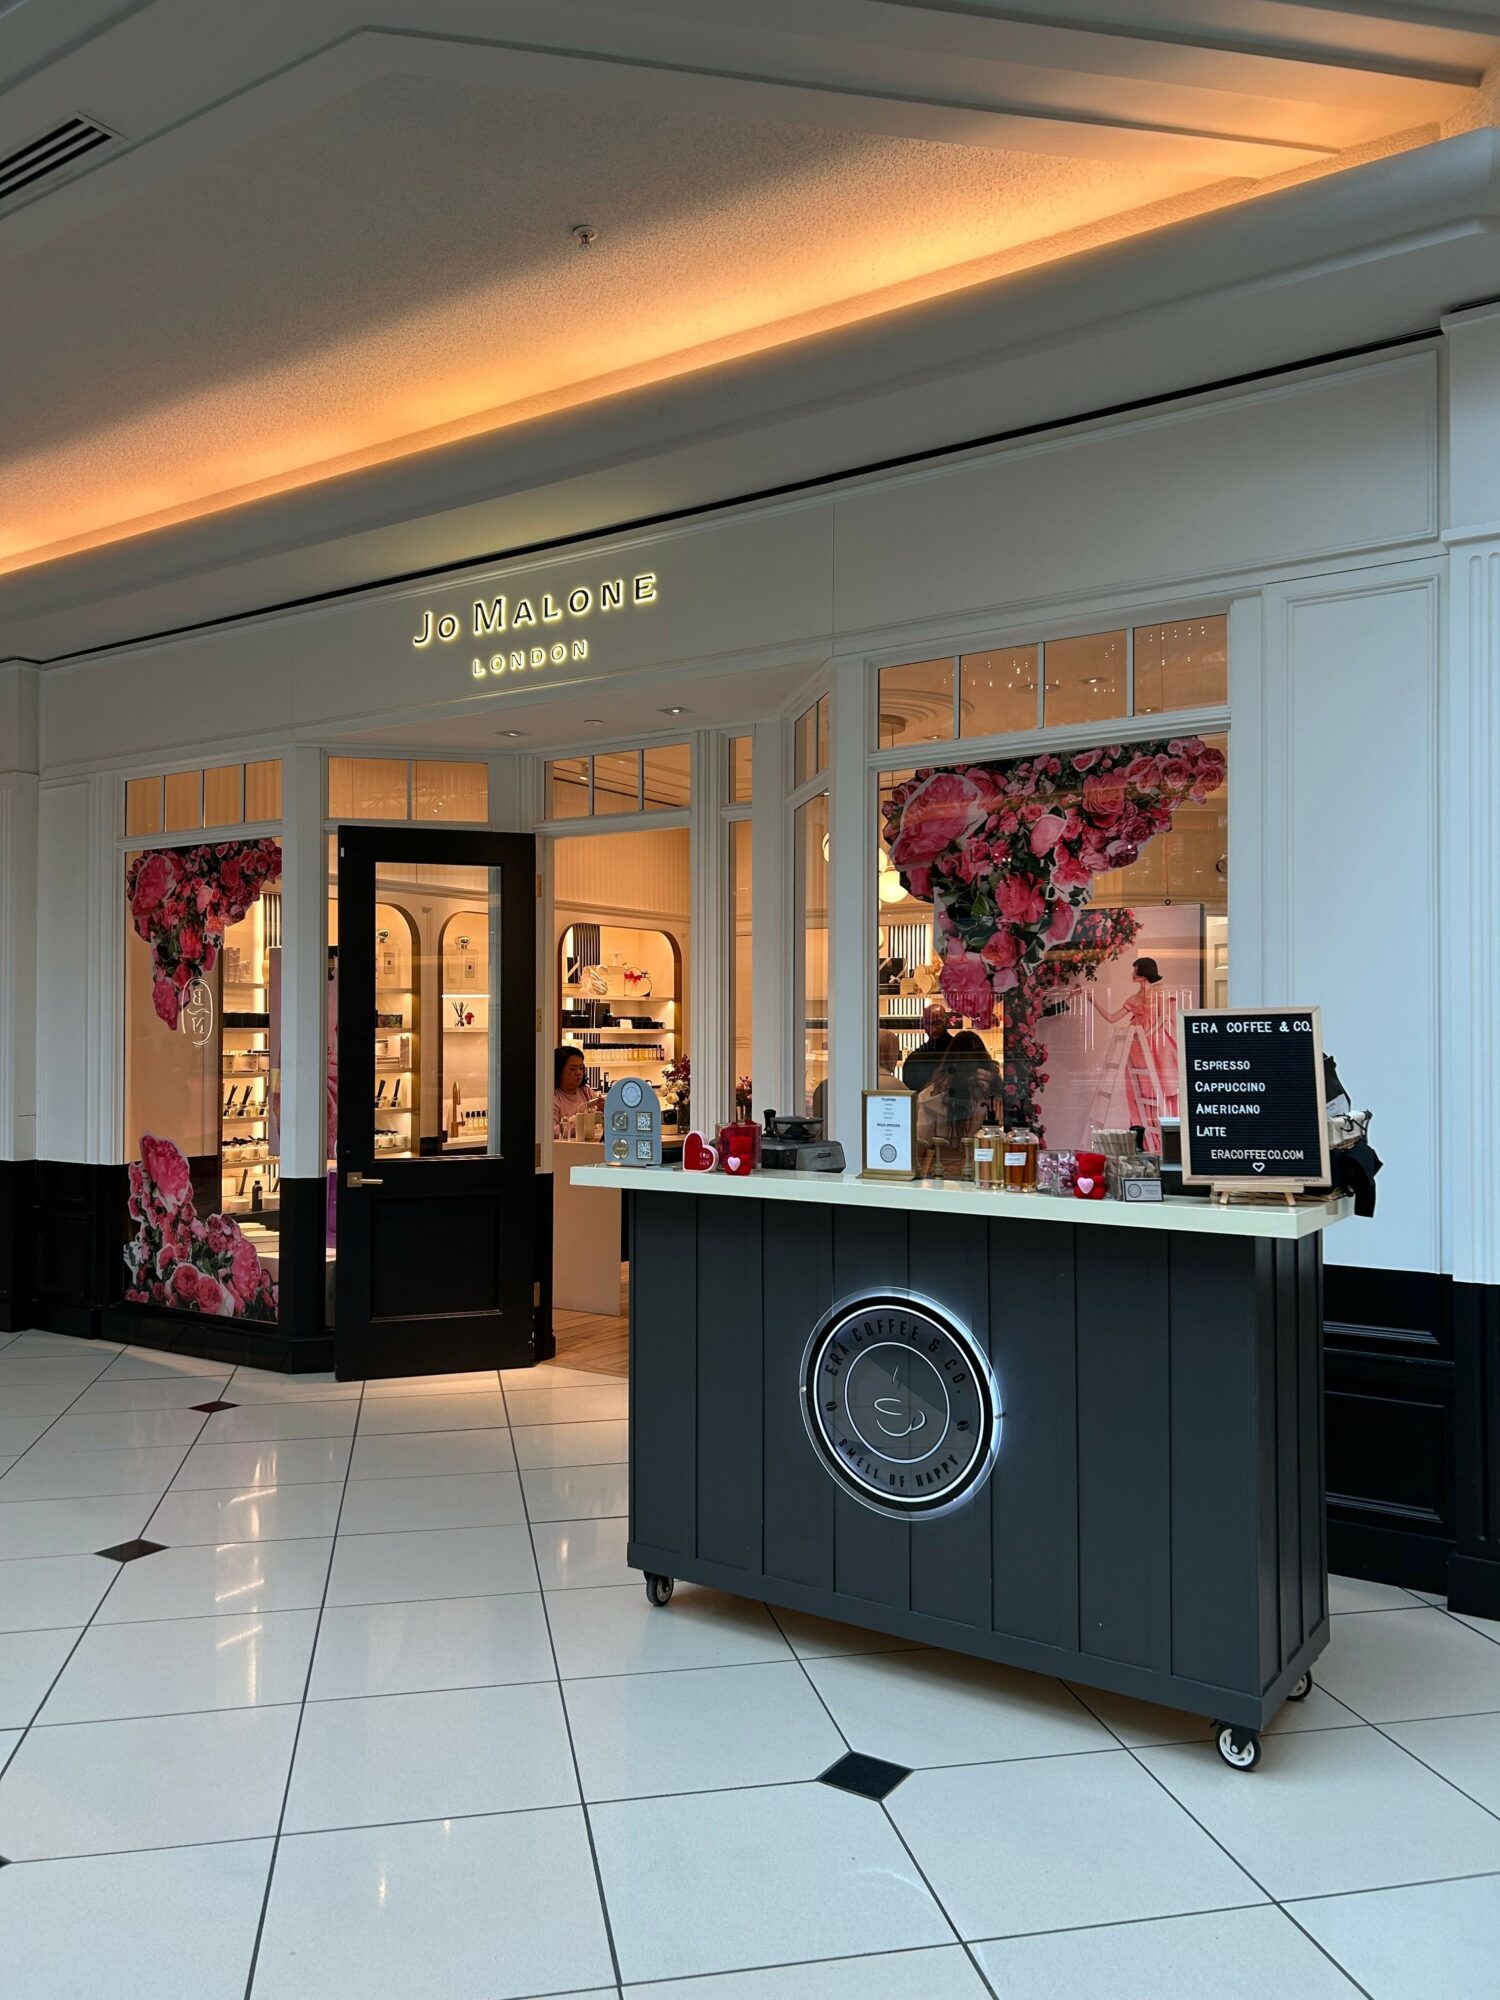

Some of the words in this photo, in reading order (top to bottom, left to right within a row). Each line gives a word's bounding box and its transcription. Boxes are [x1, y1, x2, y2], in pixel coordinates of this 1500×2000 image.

[473, 575, 655, 634] MALONE
[472, 641, 588, 676] LONDON
[1192, 1023, 1218, 1033] ERA
[1226, 1021, 1272, 1033] COFFEE
[1279, 1021, 1289, 1032] &
[1293, 1021, 1312, 1032] CO.
[1194, 1059, 1251, 1071] ESPRESSO
[1195, 1081, 1266, 1092] CAPPUCCINO
[1195, 1103, 1261, 1115] AMERICANO
[1196, 1125, 1227, 1137] LATTE
[1211, 1149, 1304, 1160] ERACOFFEECO.COM
[825, 1342, 850, 1376] ERA
[852, 1319, 920, 1342] COFFEE
[928, 1338, 941, 1353] &
[944, 1358, 966, 1394] CO.
[838, 1438, 879, 1480] SMELL
[889, 1475, 905, 1488] OF
[916, 1454, 959, 1488] HAPPY
